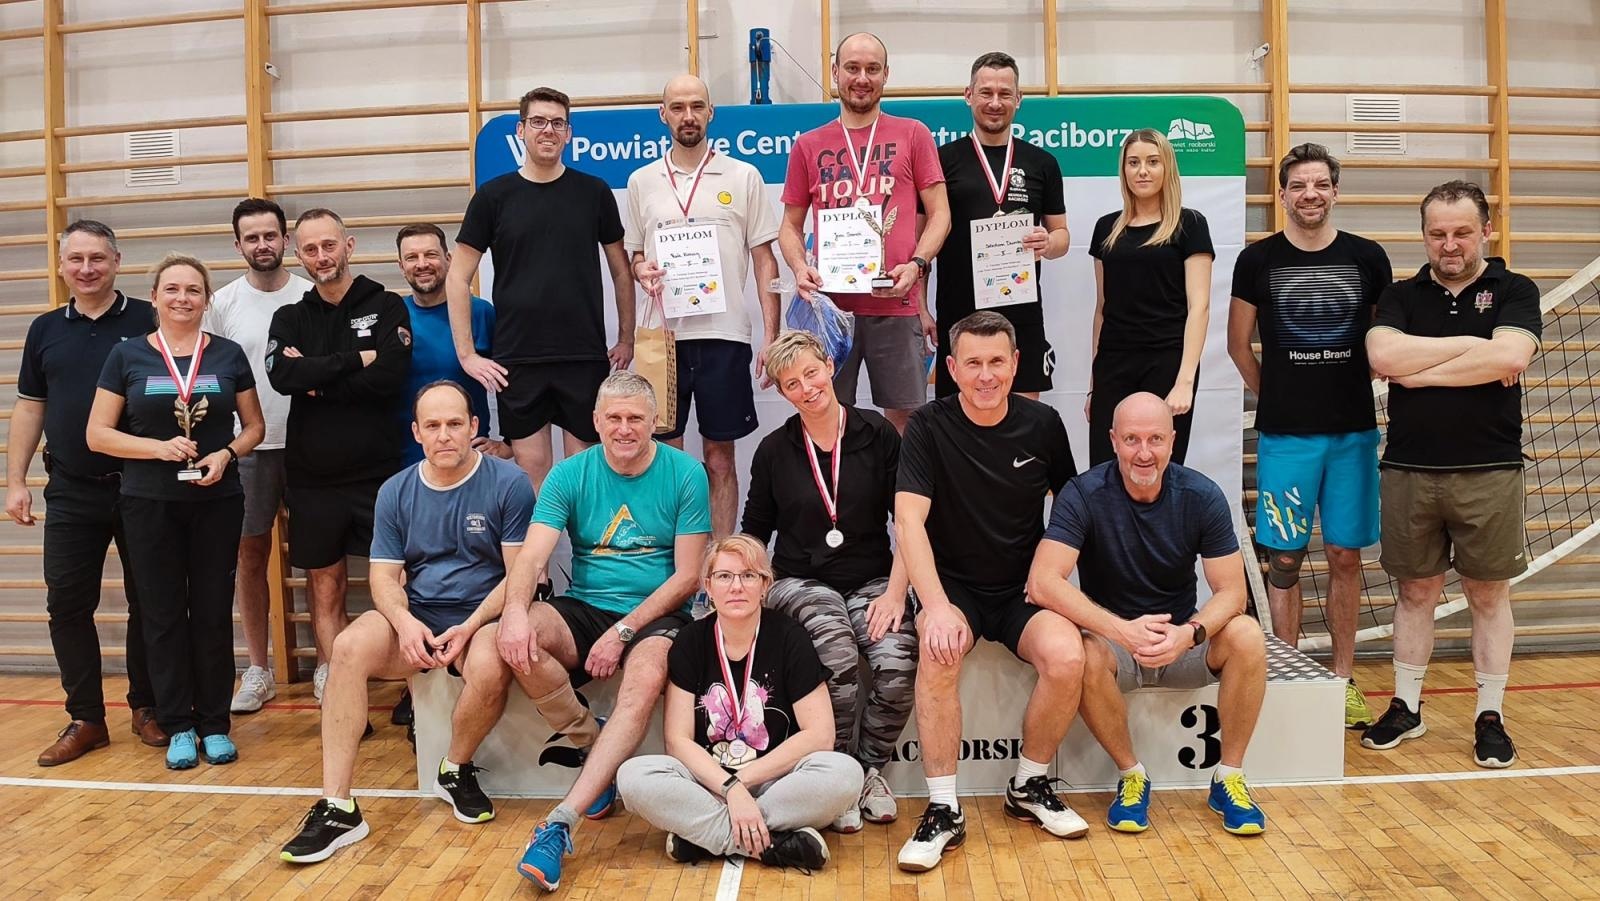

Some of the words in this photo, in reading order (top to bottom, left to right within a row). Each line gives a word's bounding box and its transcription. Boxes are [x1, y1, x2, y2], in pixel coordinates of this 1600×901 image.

[572, 134, 730, 162] Powiate
[1010, 121, 1139, 148] Raciborz
[975, 219, 1029, 233] DYPLOM
[659, 230, 713, 243] DYPLOM
[1289, 350, 1321, 360] House
[1323, 348, 1352, 359] Brand
[1178, 704, 1222, 769] 3
